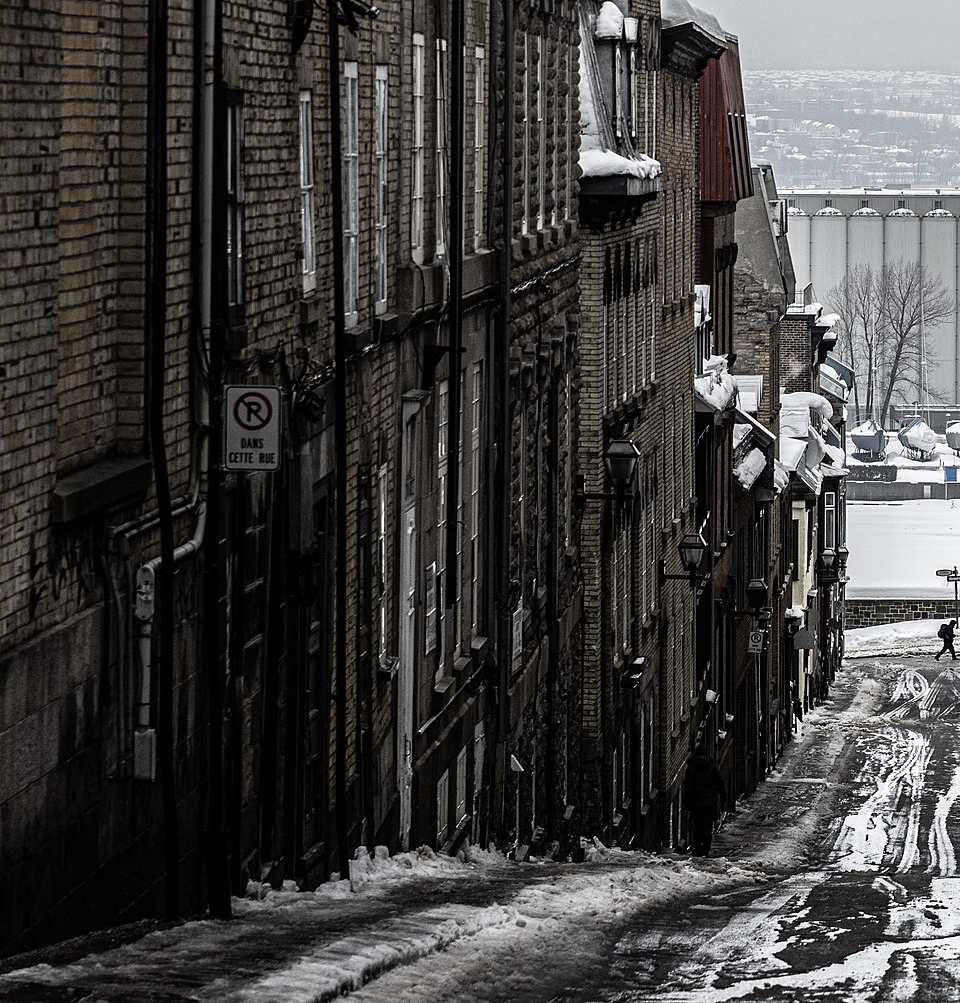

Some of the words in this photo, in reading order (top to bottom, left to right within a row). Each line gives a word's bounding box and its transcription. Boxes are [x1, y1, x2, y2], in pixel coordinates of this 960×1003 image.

[241, 438, 264, 449] DANS
[229, 452, 254, 463] CETTE
[259, 452, 276, 464] RUE
